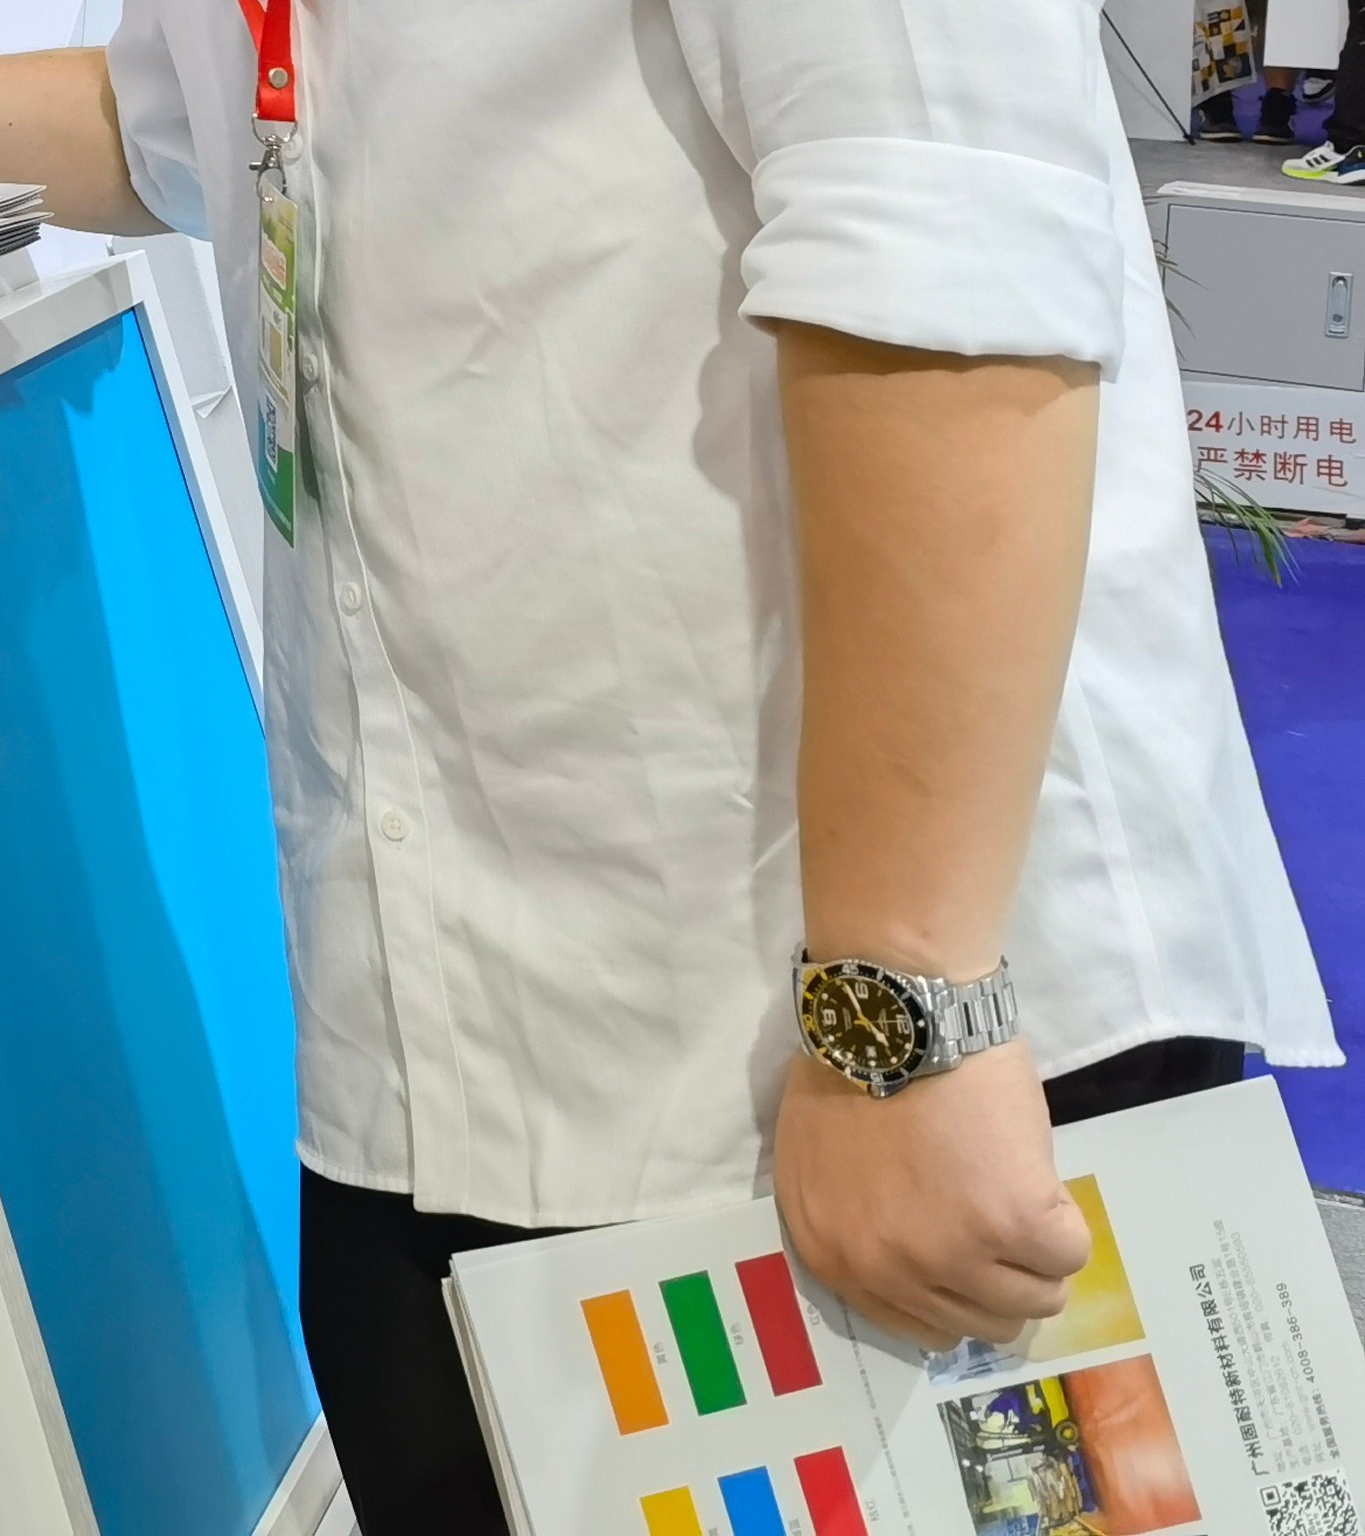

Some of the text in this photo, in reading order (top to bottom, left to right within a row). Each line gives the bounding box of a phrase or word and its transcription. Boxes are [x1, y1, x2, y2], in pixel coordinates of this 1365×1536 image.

[1187, 408, 1358, 445] 24小时用电
[1194, 446, 1349, 488] 严禁断电
[1189, 1263, 1270, 1477] 广州固耐特新材料有限公司
